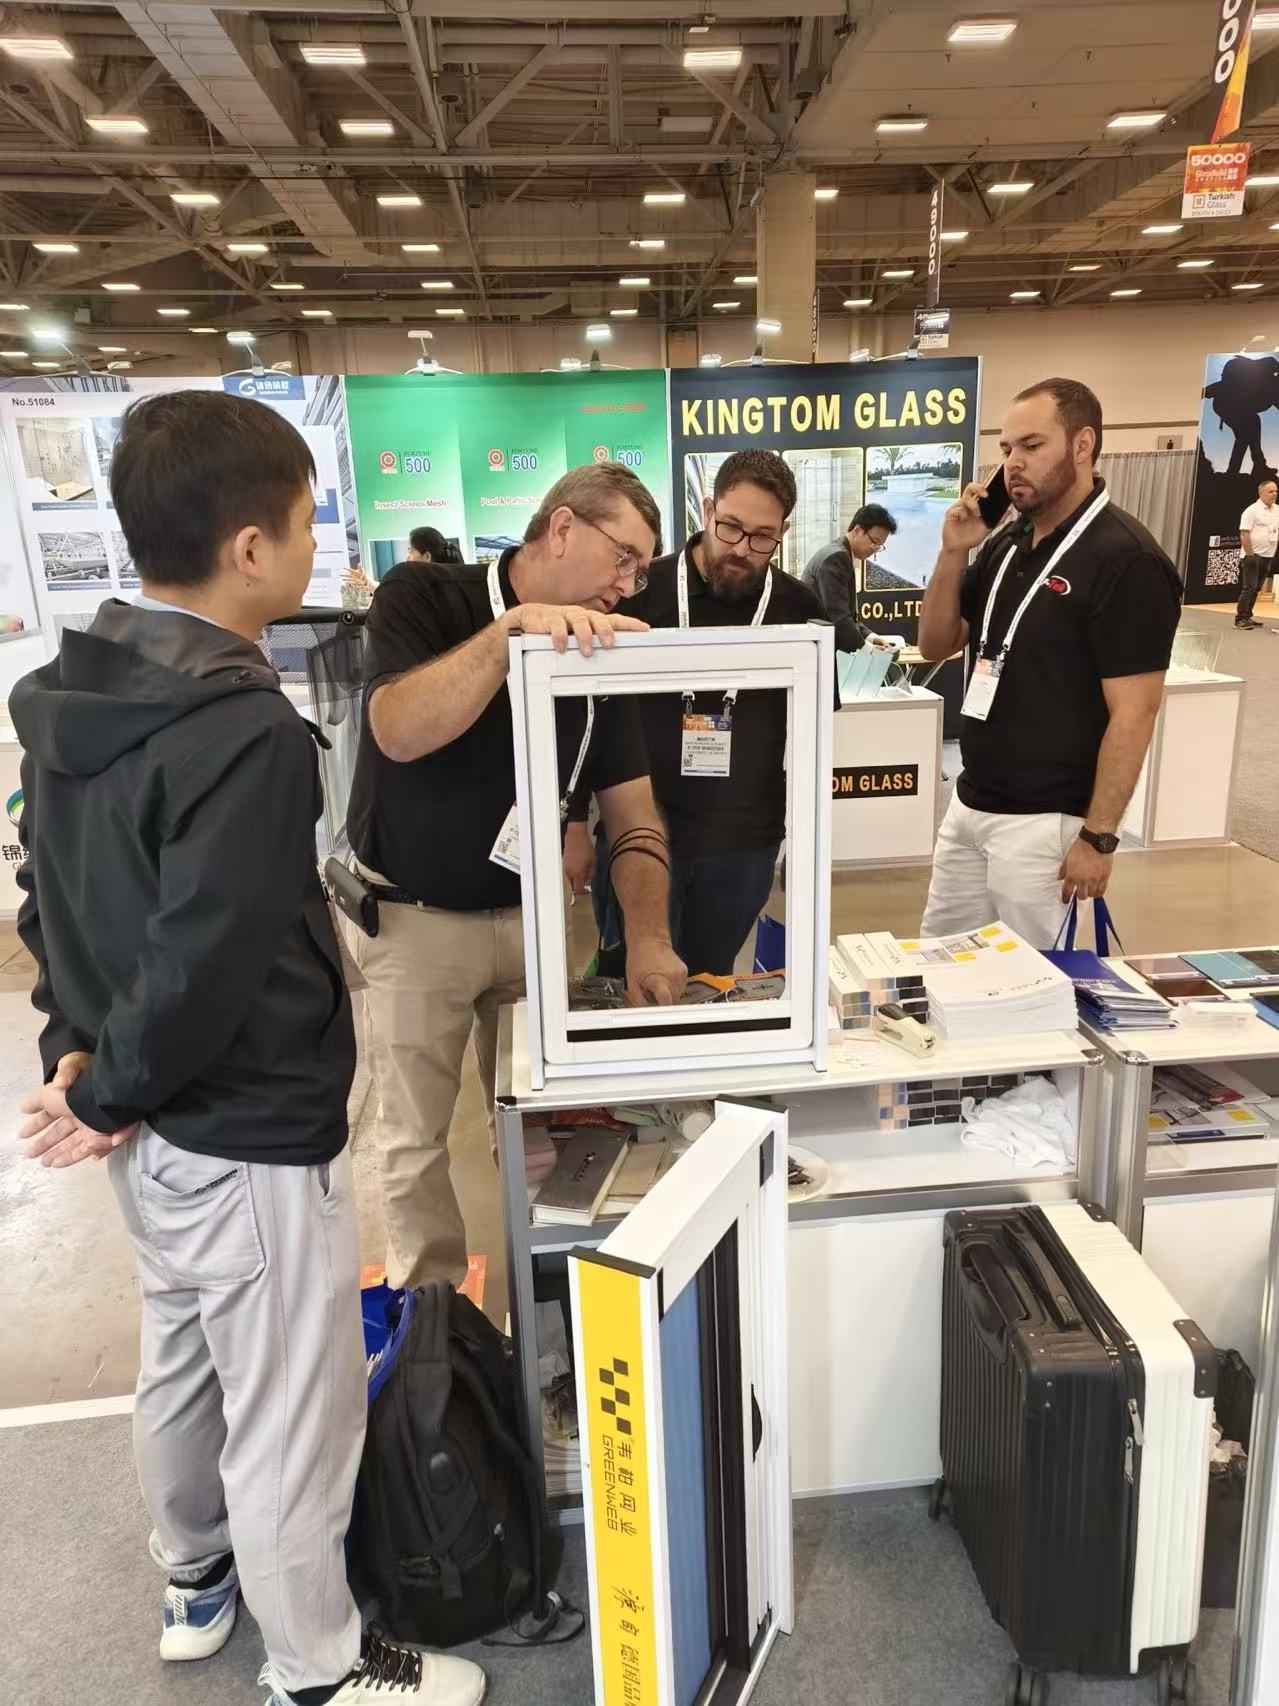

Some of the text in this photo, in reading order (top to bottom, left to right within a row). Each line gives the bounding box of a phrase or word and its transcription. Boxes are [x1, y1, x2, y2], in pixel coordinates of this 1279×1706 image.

[1191, 152, 1246, 167] 50000
[1208, 193, 1235, 201] Turkish
[1207, 201, 1227, 209] Glass
[12, 397, 55, 407] No.51084
[682, 387, 967, 436] KINGTOM GLASS
[404, 457, 431, 473] 500
[512, 454, 538, 470] 500
[375, 498, 447, 509] Insect Screen Mesh
[860, 773, 913, 792] GLASS
[602, 1434, 618, 1531] GREENWEB
